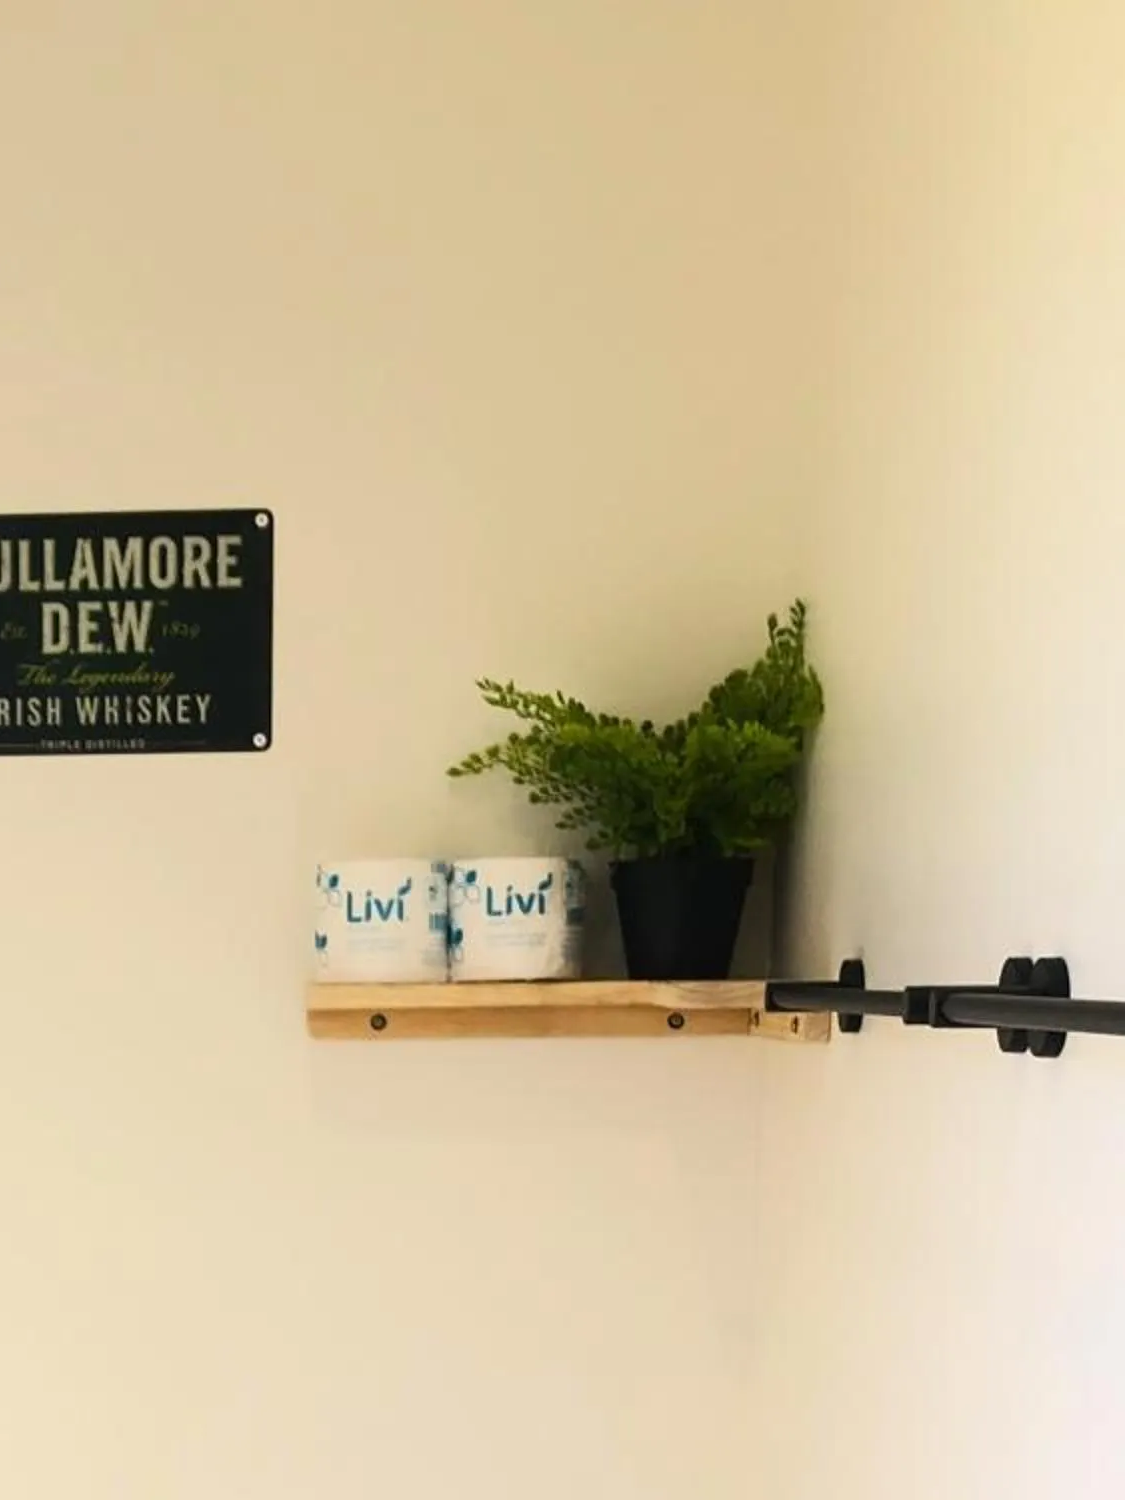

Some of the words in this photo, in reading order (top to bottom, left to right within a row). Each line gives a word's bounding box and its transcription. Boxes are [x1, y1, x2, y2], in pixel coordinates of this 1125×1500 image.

[16, 660, 57, 686] The
[61, 660, 176, 694] Legendary
[75, 694, 212, 726] WHISKEY
[346, 879, 411, 922] Livi
[486, 874, 552, 917] Livi
